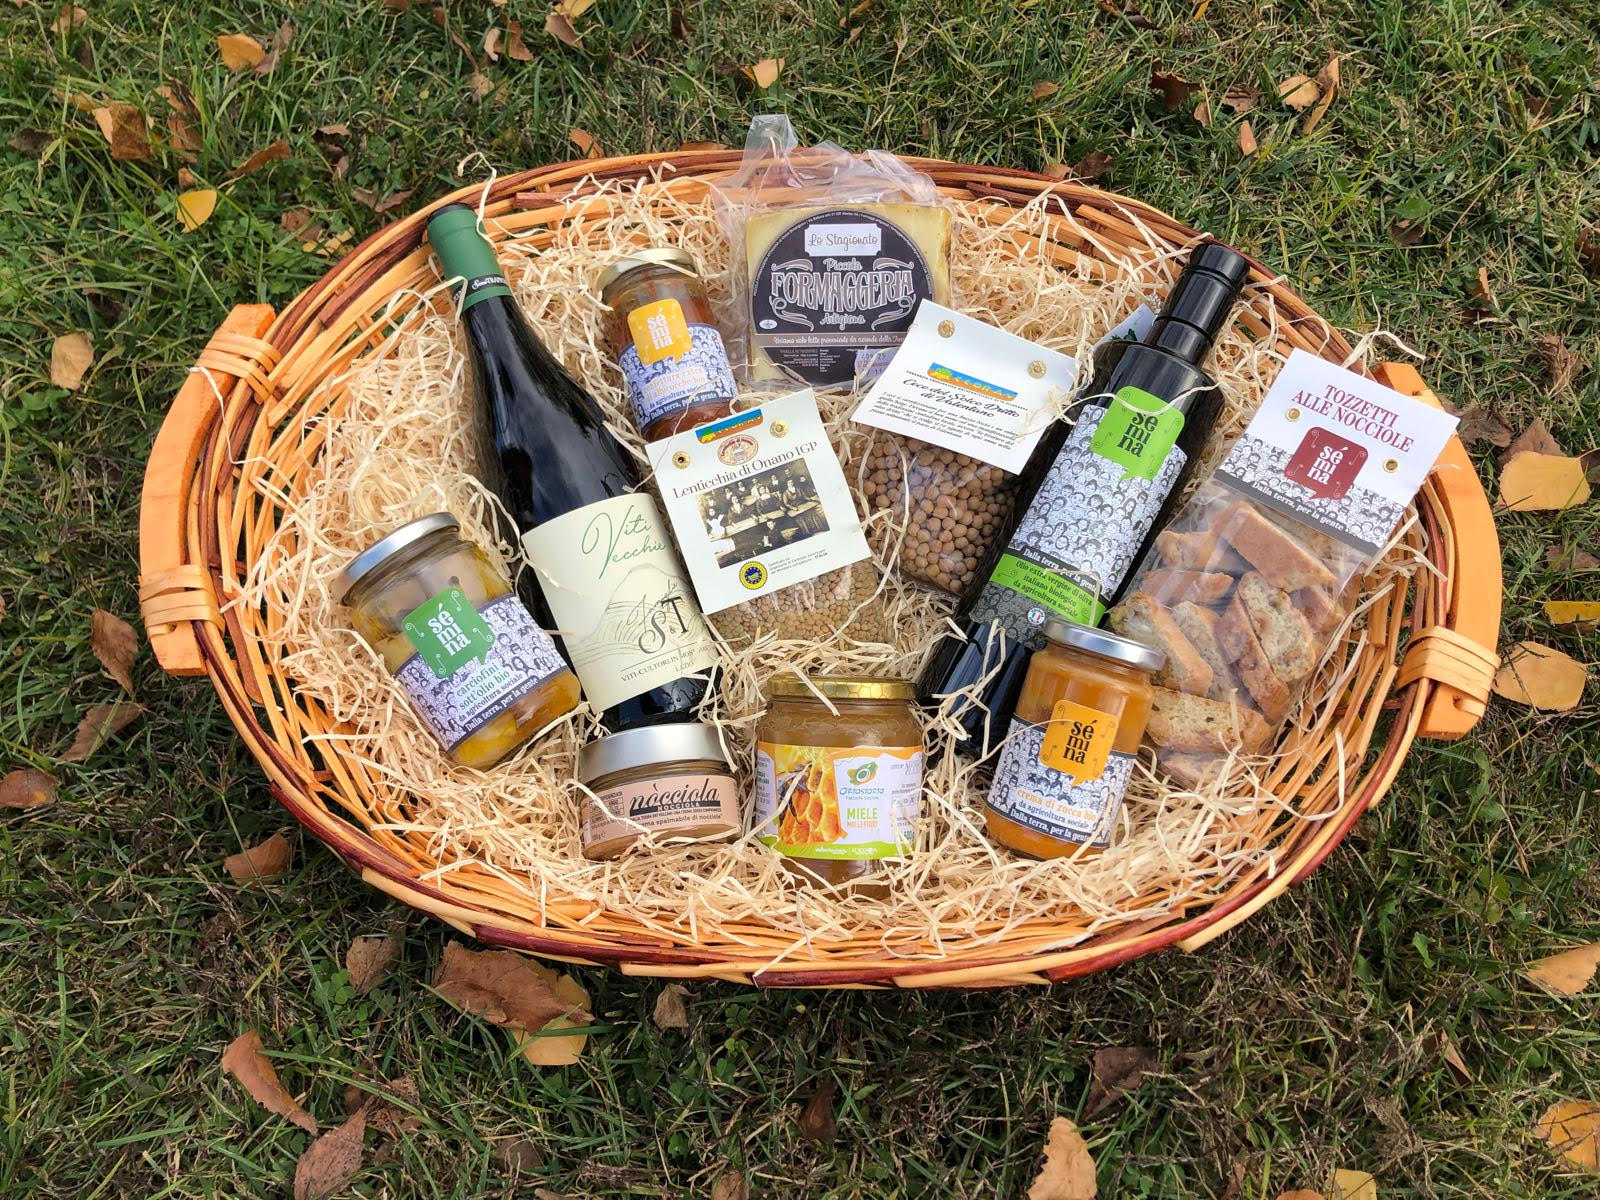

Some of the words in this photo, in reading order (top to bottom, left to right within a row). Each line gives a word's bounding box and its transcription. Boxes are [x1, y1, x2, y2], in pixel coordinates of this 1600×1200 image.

[826, 233, 878, 251] Stagionato
[823, 257, 863, 272] Piccola
[771, 270, 914, 312] FORMAGGERIA
[648, 307, 666, 328] sé
[820, 312, 866, 331] Artigiana
[920, 392, 935, 400] di
[935, 394, 995, 418] Valentano
[929, 386, 950, 396] del
[948, 393, 982, 406] Solco
[983, 403, 1020, 418] Dritto
[1324, 384, 1400, 428] TOZZETTI
[1125, 423, 1152, 445] mi
[1291, 389, 1335, 417] ALLE
[1334, 405, 1415, 453] NOCCIOLE
[1117, 434, 1144, 458] na
[1318, 445, 1349, 465] sé
[672, 470, 737, 498] Lenticchia
[738, 464, 750, 476] di
[751, 450, 794, 472] Onano
[795, 441, 818, 456] IGP
[1306, 466, 1331, 486] na
[1312, 455, 1336, 476] mi
[1252, 481, 1272, 496] Dalla
[1273, 491, 1295, 509] terra,
[1296, 503, 1312, 515] per
[1311, 509, 1320, 520] la
[1319, 516, 1344, 531] gente
[1016, 560, 1030, 571] Olio
[1029, 567, 1046, 579] extra
[1047, 576, 1072, 593] vergine
[1072, 587, 1080, 596] di
[1023, 548, 1041, 561] Dalla
[1081, 579, 1097, 592] gent
[1013, 579, 1022, 588] da
[1021, 584, 1057, 606] agricoltura
[1023, 574, 1048, 590] italiano
[1048, 586, 1077, 607] biologico
[427, 602, 454, 634] sé
[436, 623, 462, 646] mi
[443, 634, 471, 657] na
[457, 662, 500, 697] carciofini
[460, 682, 495, 710] sott'olio
[494, 670, 510, 684] bio
[465, 716, 484, 732] Dalla
[481, 704, 502, 719] terra,
[500, 693, 513, 708] per
[512, 688, 521, 698] la
[520, 677, 539, 694] gente
[466, 689, 501, 718] agricoltura
[501, 673, 524, 691] sociale
[1070, 719, 1098, 740] sé
[1063, 746, 1086, 765] na
[1066, 735, 1090, 752] mi
[630, 778, 720, 812] nòcciola
[657, 801, 700, 812] NOCCIOLA
[1017, 789, 1043, 805] crema
[1046, 799, 1055, 809] di
[1057, 804, 1084, 818] zucca
[656, 816, 690, 826] spalmabile
[847, 807, 878, 819] MIELE
[1011, 808, 1028, 823] Dalla
[1028, 817, 1049, 832] terra,
[1050, 825, 1064, 836] per
[1064, 829, 1072, 838] la
[1019, 801, 1027, 809] da
[1027, 805, 1066, 823] agricoltura
[1067, 819, 1090, 829] sociale
